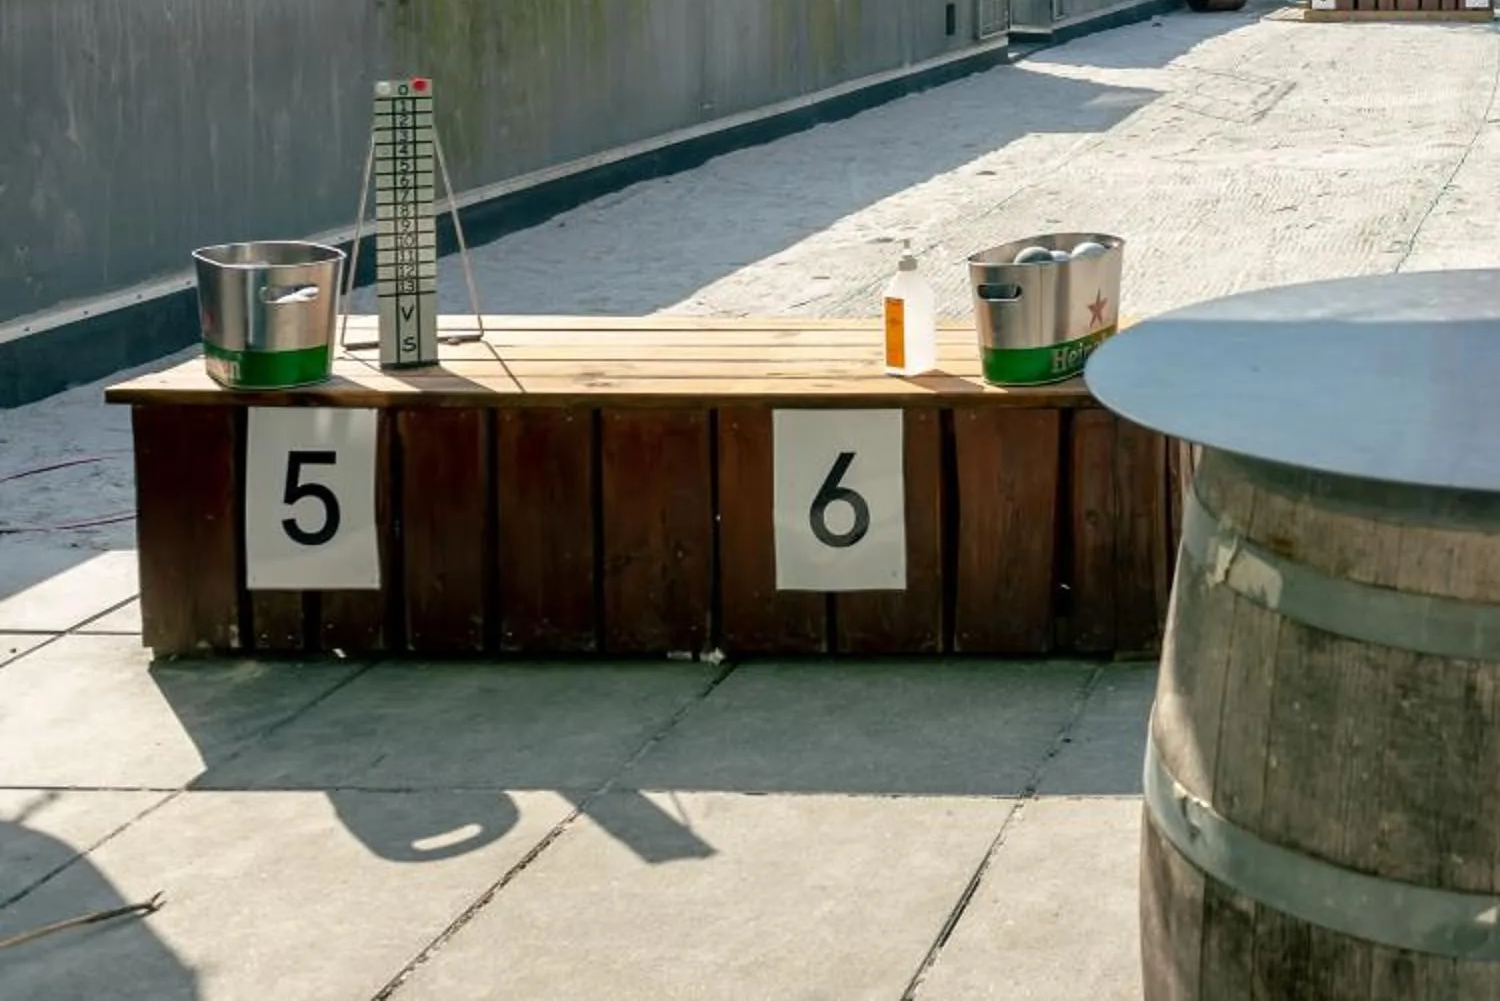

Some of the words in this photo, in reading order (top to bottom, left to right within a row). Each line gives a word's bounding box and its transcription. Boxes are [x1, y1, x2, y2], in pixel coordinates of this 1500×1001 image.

[401, 304, 415, 321] V
[402, 336, 417, 352] S
[282, 450, 341, 546] 5
[808, 451, 870, 548] 6
